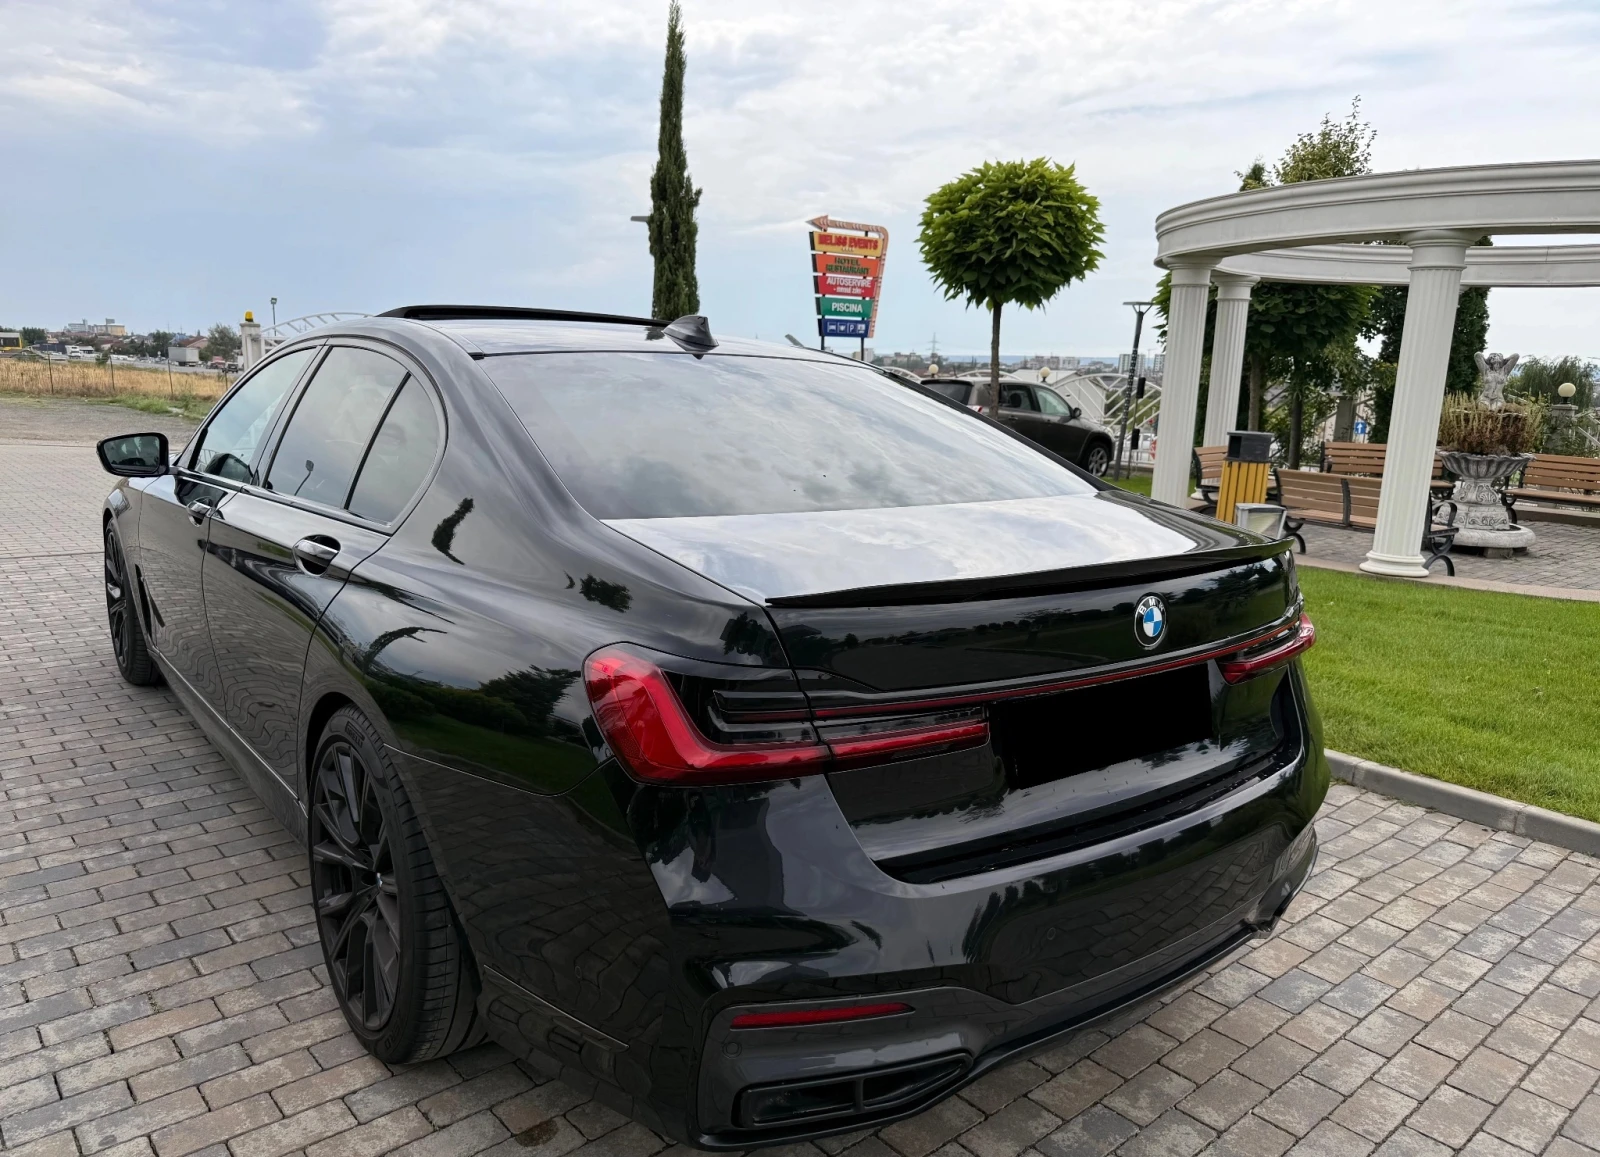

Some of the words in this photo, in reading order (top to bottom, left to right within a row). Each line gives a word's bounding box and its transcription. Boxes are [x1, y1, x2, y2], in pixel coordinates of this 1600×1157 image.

[848, 237, 879, 250] EVENTS
[834, 256, 861, 266] HOTEL
[825, 264, 870, 275] RESTAURANT
[826, 277, 872, 288] AUTOSERVIRE
[831, 302, 863, 313] PISCINA
[1138, 598, 1165, 616] BMW
[344, 720, 366, 749] PIRELLI
